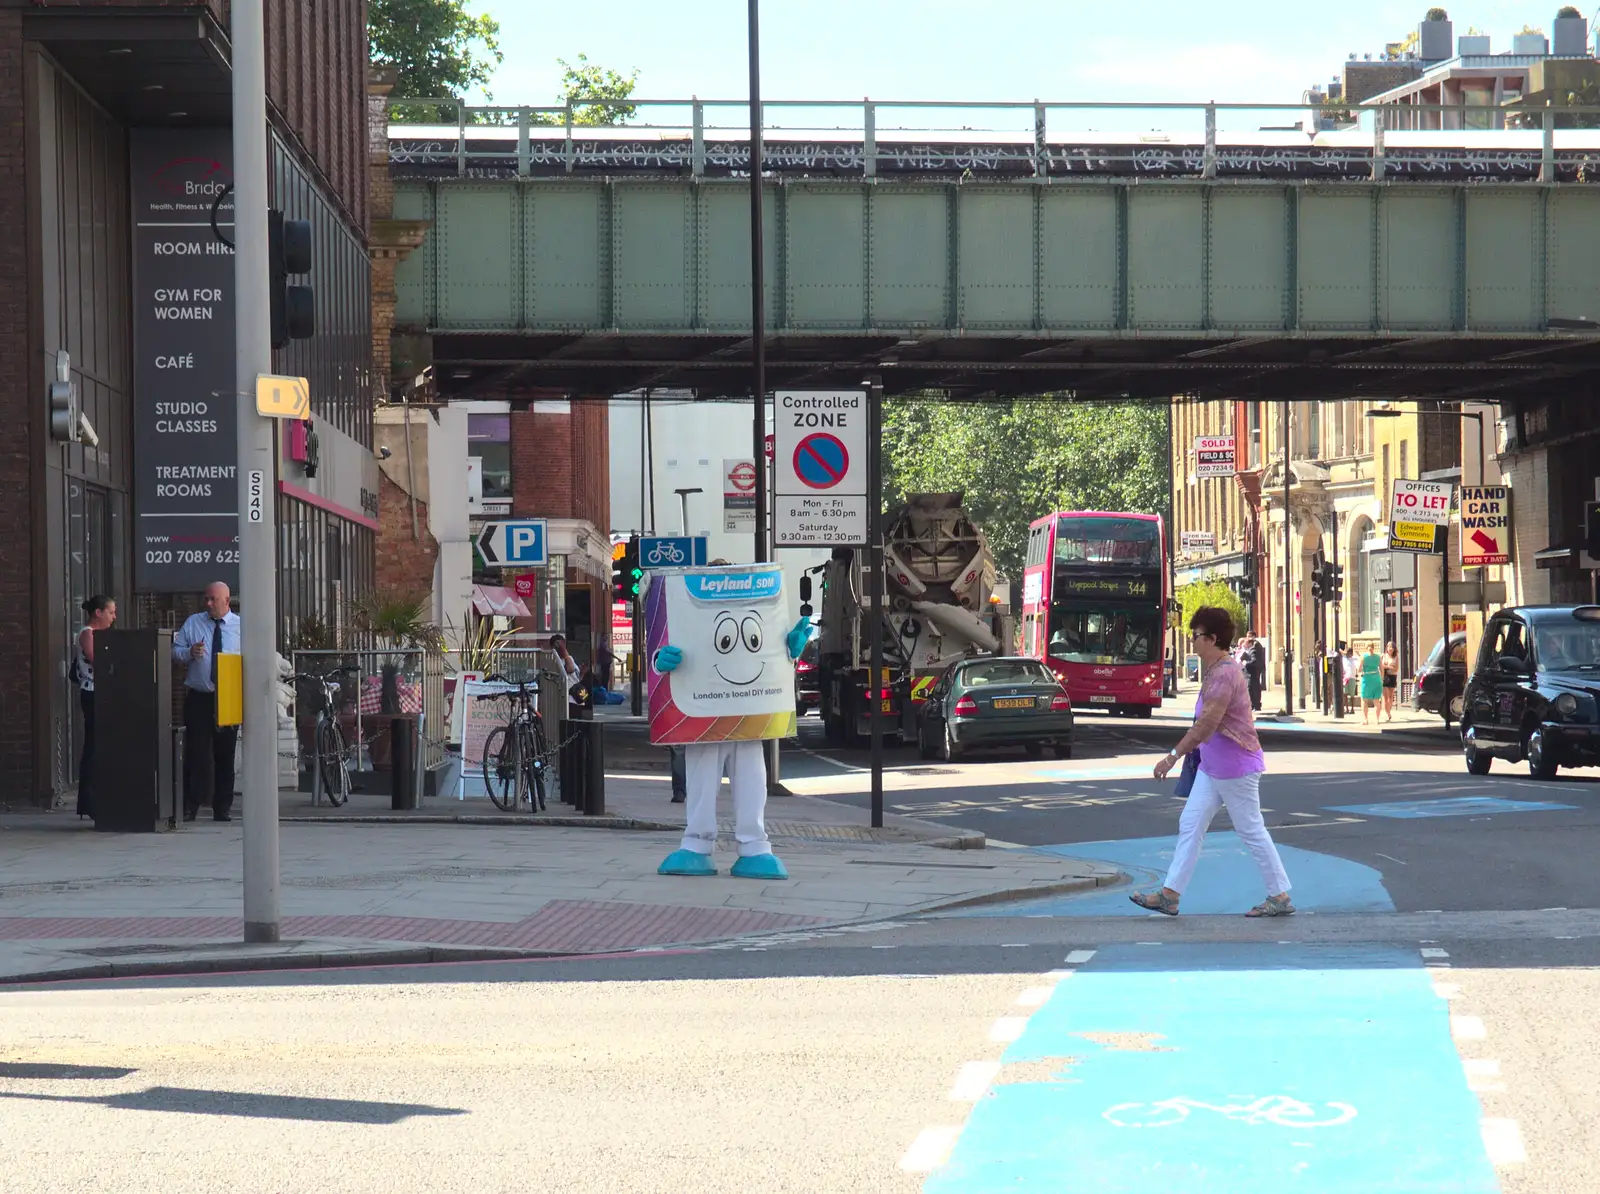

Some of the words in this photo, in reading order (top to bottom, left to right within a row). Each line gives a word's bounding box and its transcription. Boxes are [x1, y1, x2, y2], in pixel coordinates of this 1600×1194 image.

[154, 243, 201, 255] ROOM
[154, 289, 188, 301] GYM
[194, 289, 222, 301] FOR
[155, 308, 213, 319] WOMEN
[155, 353, 193, 368] CAFÉ
[783, 396, 858, 408] Controlled
[156, 402, 208, 415] STUDIO
[156, 420, 217, 432] CLASSES
[794, 413, 847, 427] ZONE
[156, 466, 236, 479] TREATMENT
[157, 484, 212, 496] ROOMS
[1406, 483, 1440, 492] OFFICES
[251, 472, 260, 521] SS40
[1463, 488, 1505, 500] HAND
[1396, 493, 1417, 507] TO
[1423, 496, 1448, 509] LET
[1468, 502, 1500, 514] CAR
[1463, 516, 1507, 528] WASH
[799, 524, 838, 533] Saturday
[1400, 530, 1430, 538] Symmons
[513, 528, 536, 558] P
[146, 551, 172, 563] 020
[176, 550, 211, 563] 7089
[216, 550, 240, 563] 625
[701, 575, 753, 592] Leyland
[756, 577, 774, 588] SDM
[1069, 581, 1097, 591] Liverpool
[1100, 581, 1118, 591] Street
[1127, 582, 1146, 594] 344
[693, 692, 730, 700] London's
[732, 690, 751, 698] local
